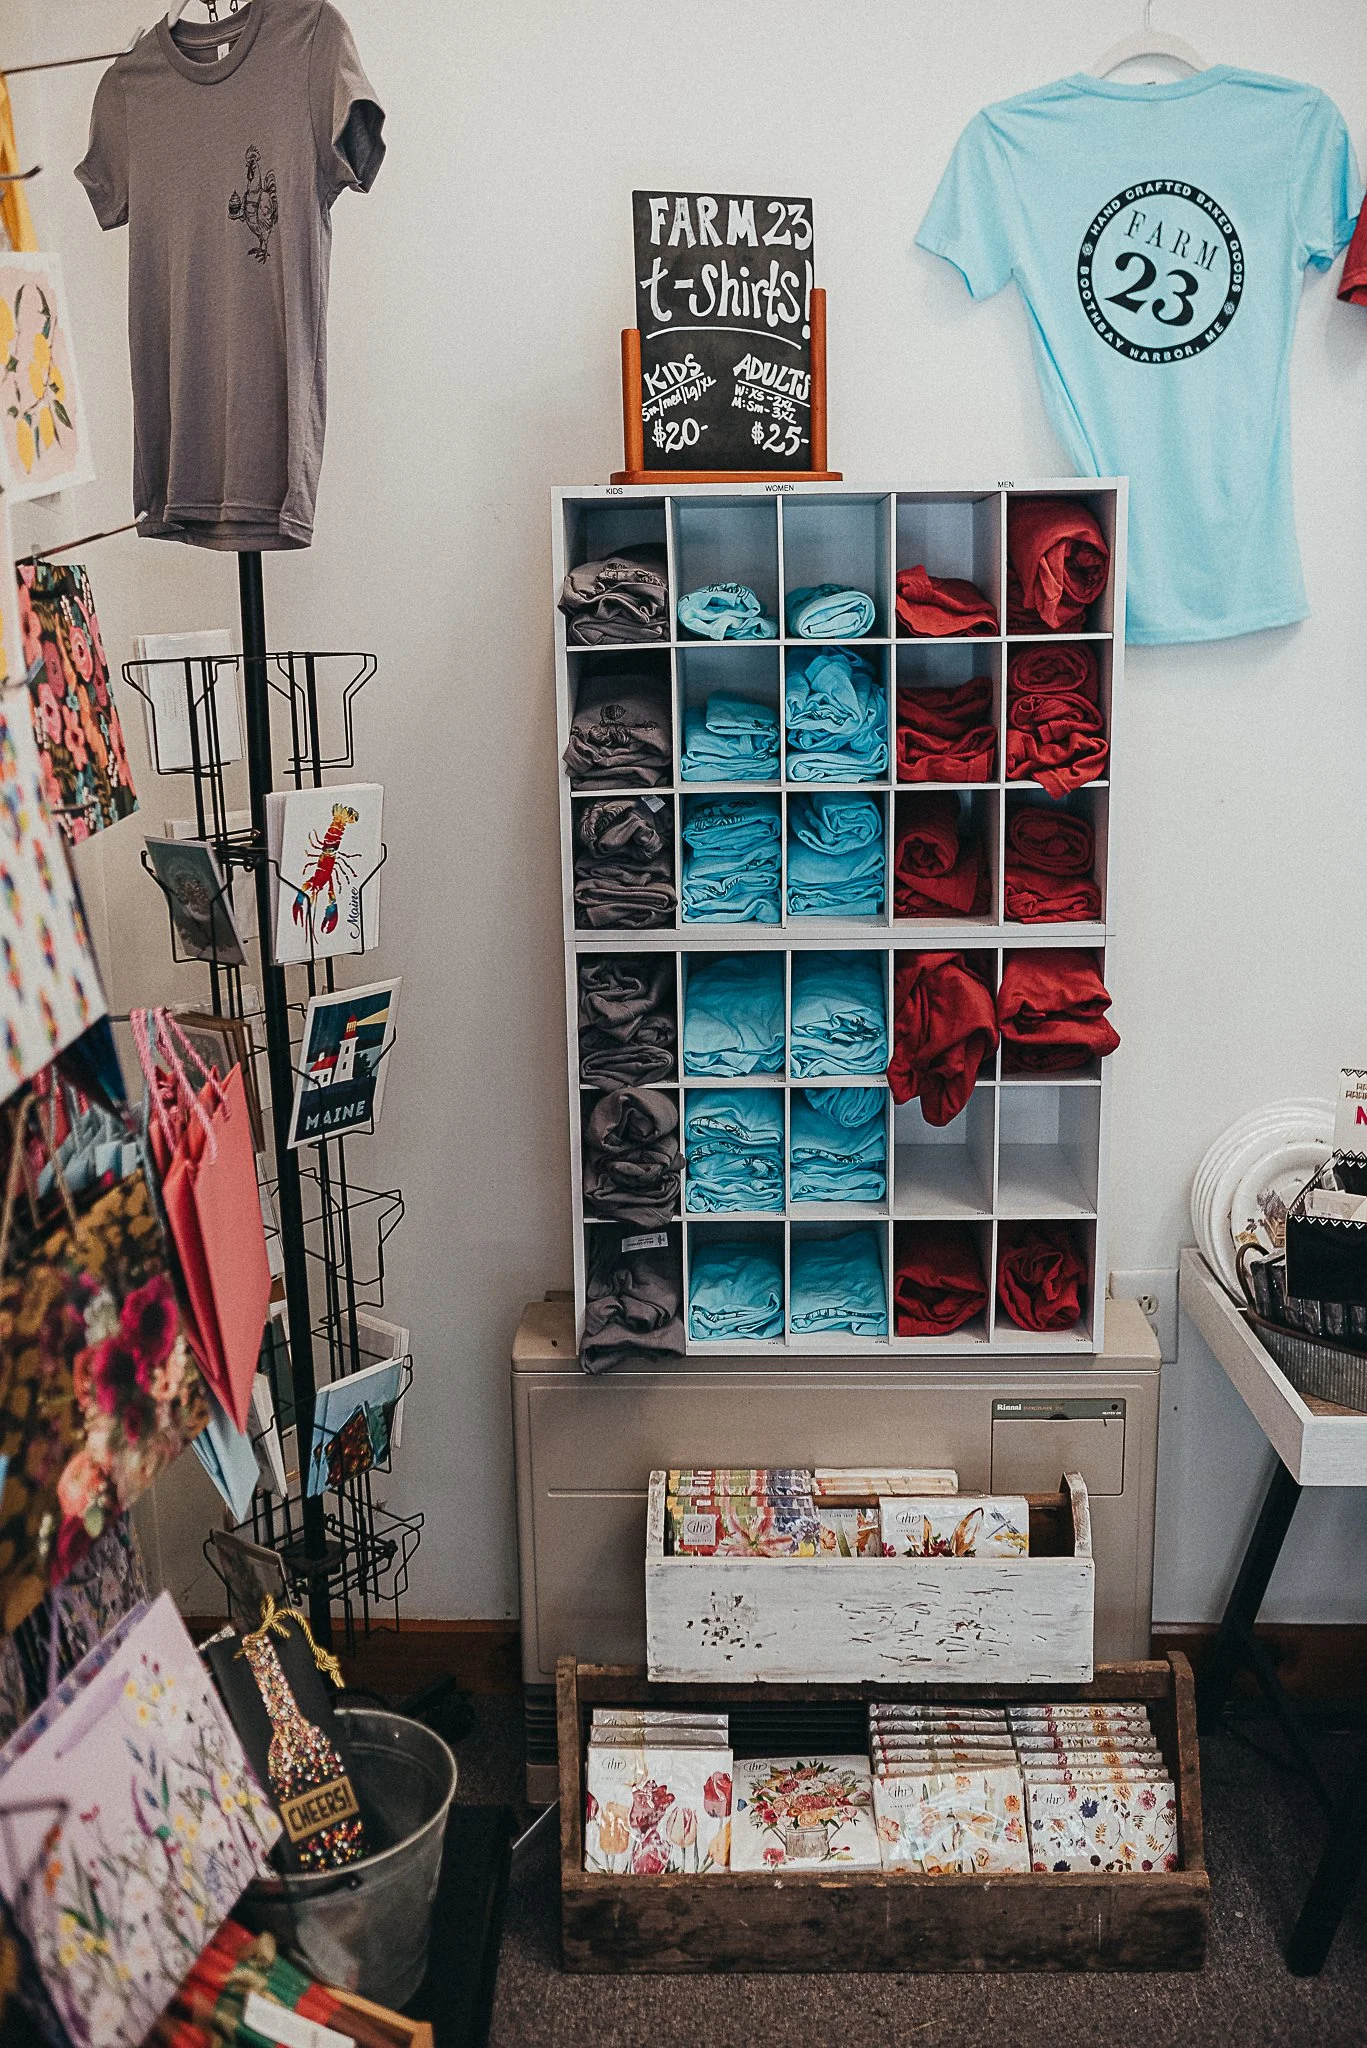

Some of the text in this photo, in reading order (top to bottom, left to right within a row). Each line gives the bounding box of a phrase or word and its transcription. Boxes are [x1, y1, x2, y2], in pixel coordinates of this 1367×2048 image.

[648, 196, 812, 250] FARM 23
[1090, 181, 1243, 293] HAND CRAFTED BAKED GOODS
[1123, 209, 1220, 273] FARM
[1104, 252, 1199, 327] 23
[1080, 265, 1224, 362] BOOTHBAY HARBOR, ME
[643, 353, 702, 396] KIDS
[732, 353, 811, 400] ADULTS
[765, 484, 794, 492] WOMEN
[348, 886, 360, 939] Maine
[305, 1100, 366, 1131] MAINE
[692, 1521, 709, 1533] ihr
[901, 1512, 915, 1524] ihr
[607, 1757, 623, 1769] ihr
[749, 1761, 764, 1771] ihr
[288, 1783, 353, 1833] CHEERS!
[894, 1785, 909, 1798] ihr
[1046, 1793, 1061, 1804] ihr
